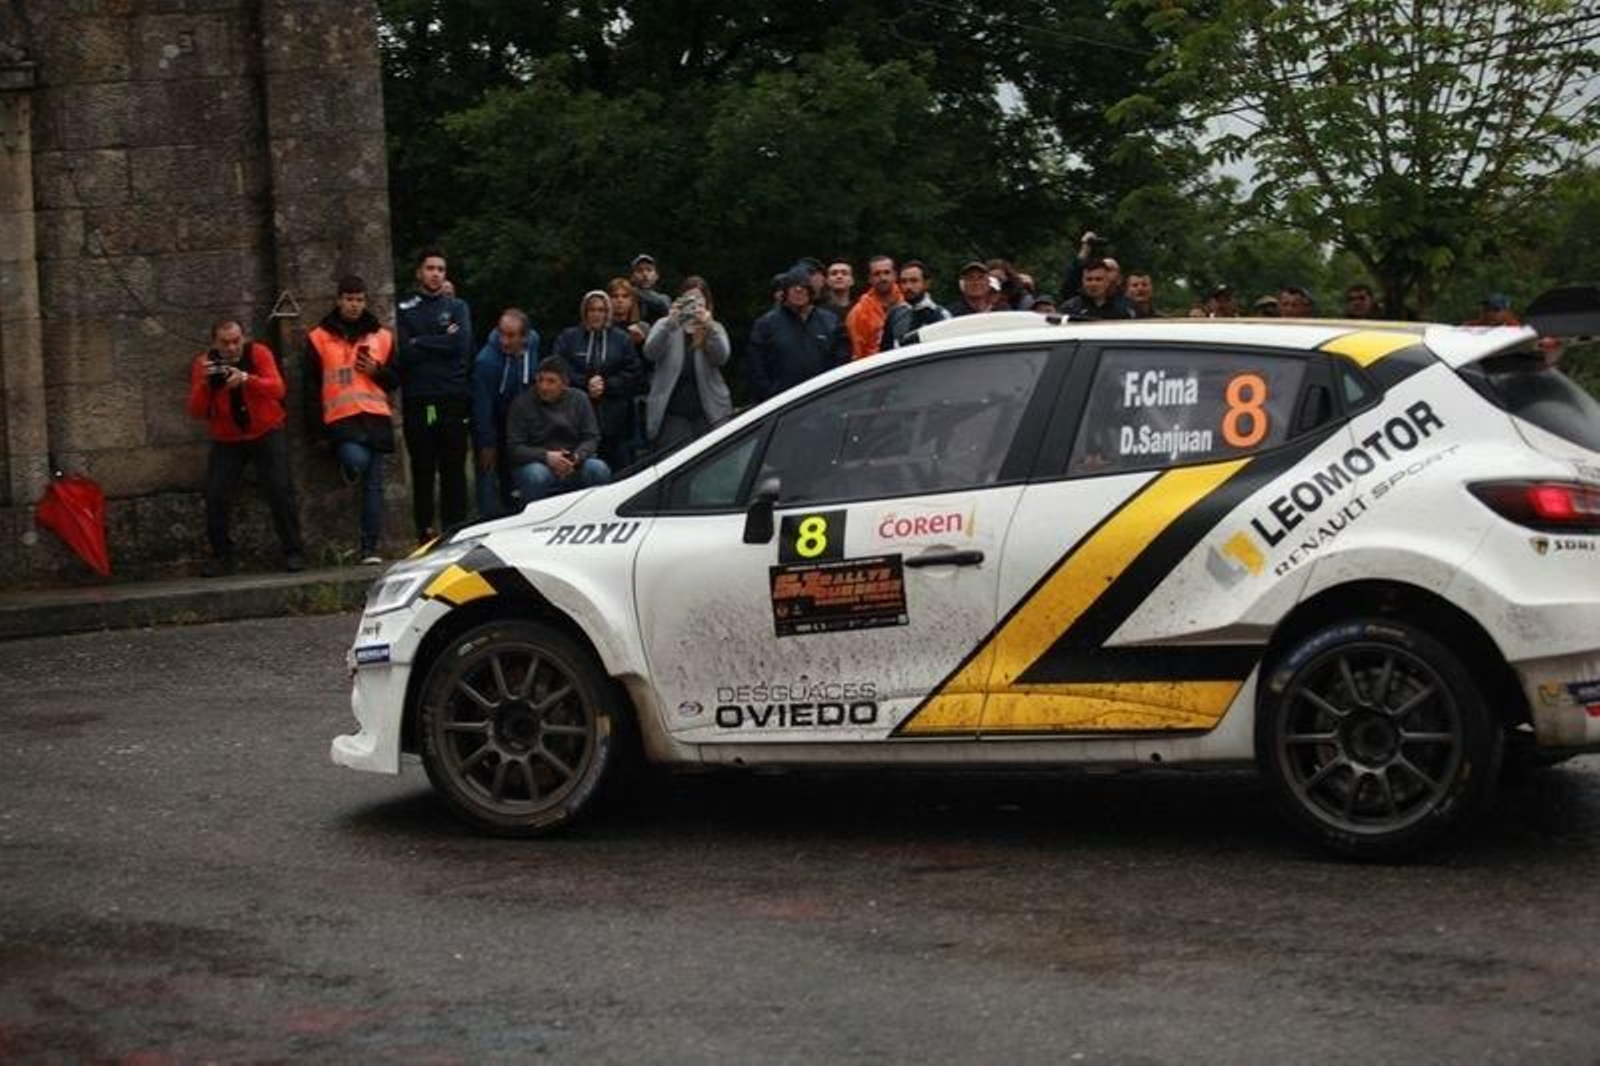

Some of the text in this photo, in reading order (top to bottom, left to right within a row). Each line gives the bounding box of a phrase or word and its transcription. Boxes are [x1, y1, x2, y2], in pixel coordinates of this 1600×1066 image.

[1123, 371, 1199, 409] F.Cima
[1221, 373, 1269, 449] 8
[1119, 425, 1213, 459] D.Sanjuan
[1250, 399, 1446, 549] LEOMOTOR
[1273, 443, 1462, 578] RENAULT SPORT
[547, 521, 640, 545] ROXU
[795, 515, 829, 559] 8
[716, 682, 878, 704] DESGUACES
[715, 702, 878, 729] OVIEDO
